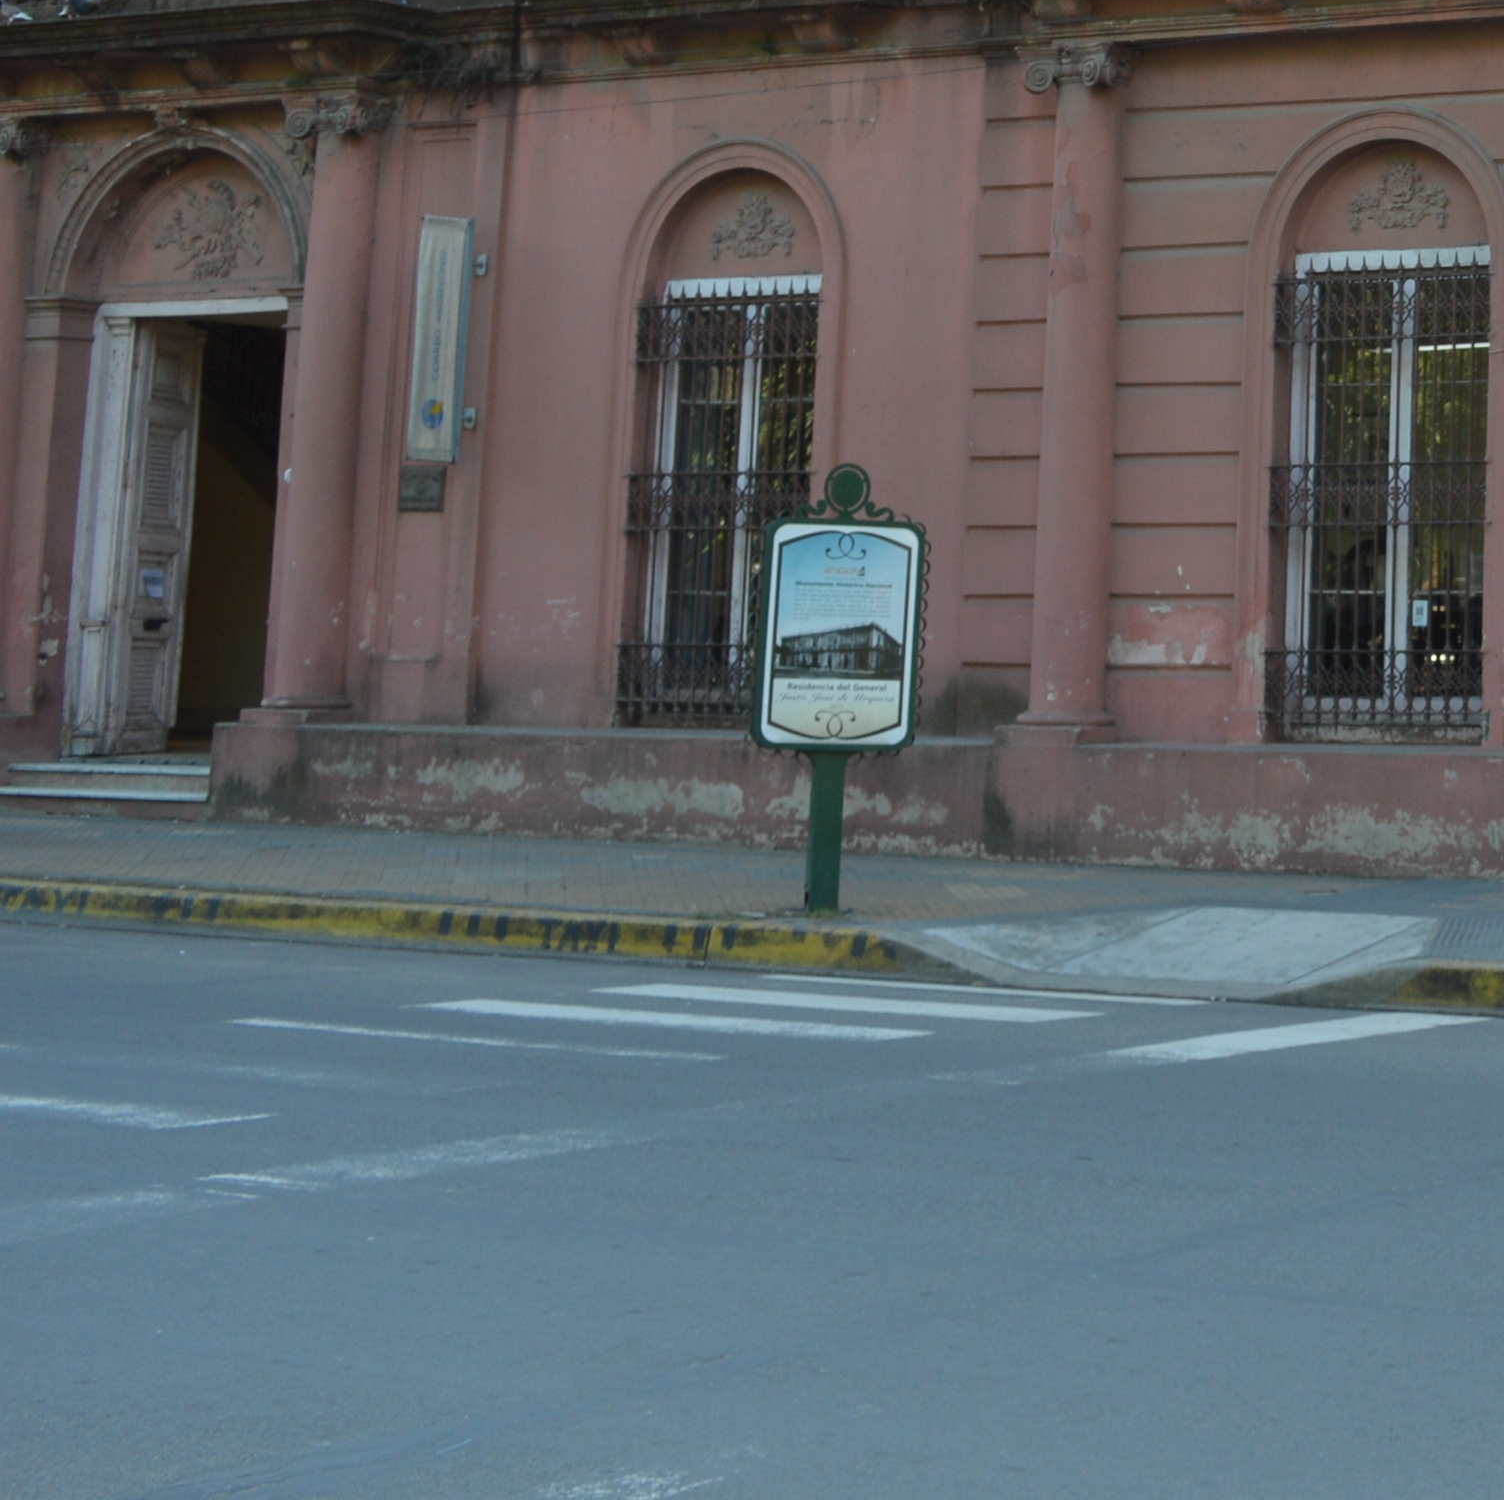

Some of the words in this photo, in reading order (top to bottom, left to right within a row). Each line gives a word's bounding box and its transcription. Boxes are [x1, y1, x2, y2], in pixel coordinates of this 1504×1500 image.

[787, 682, 834, 691] Residencia
[836, 682, 851, 690] del
[852, 682, 887, 692] General
